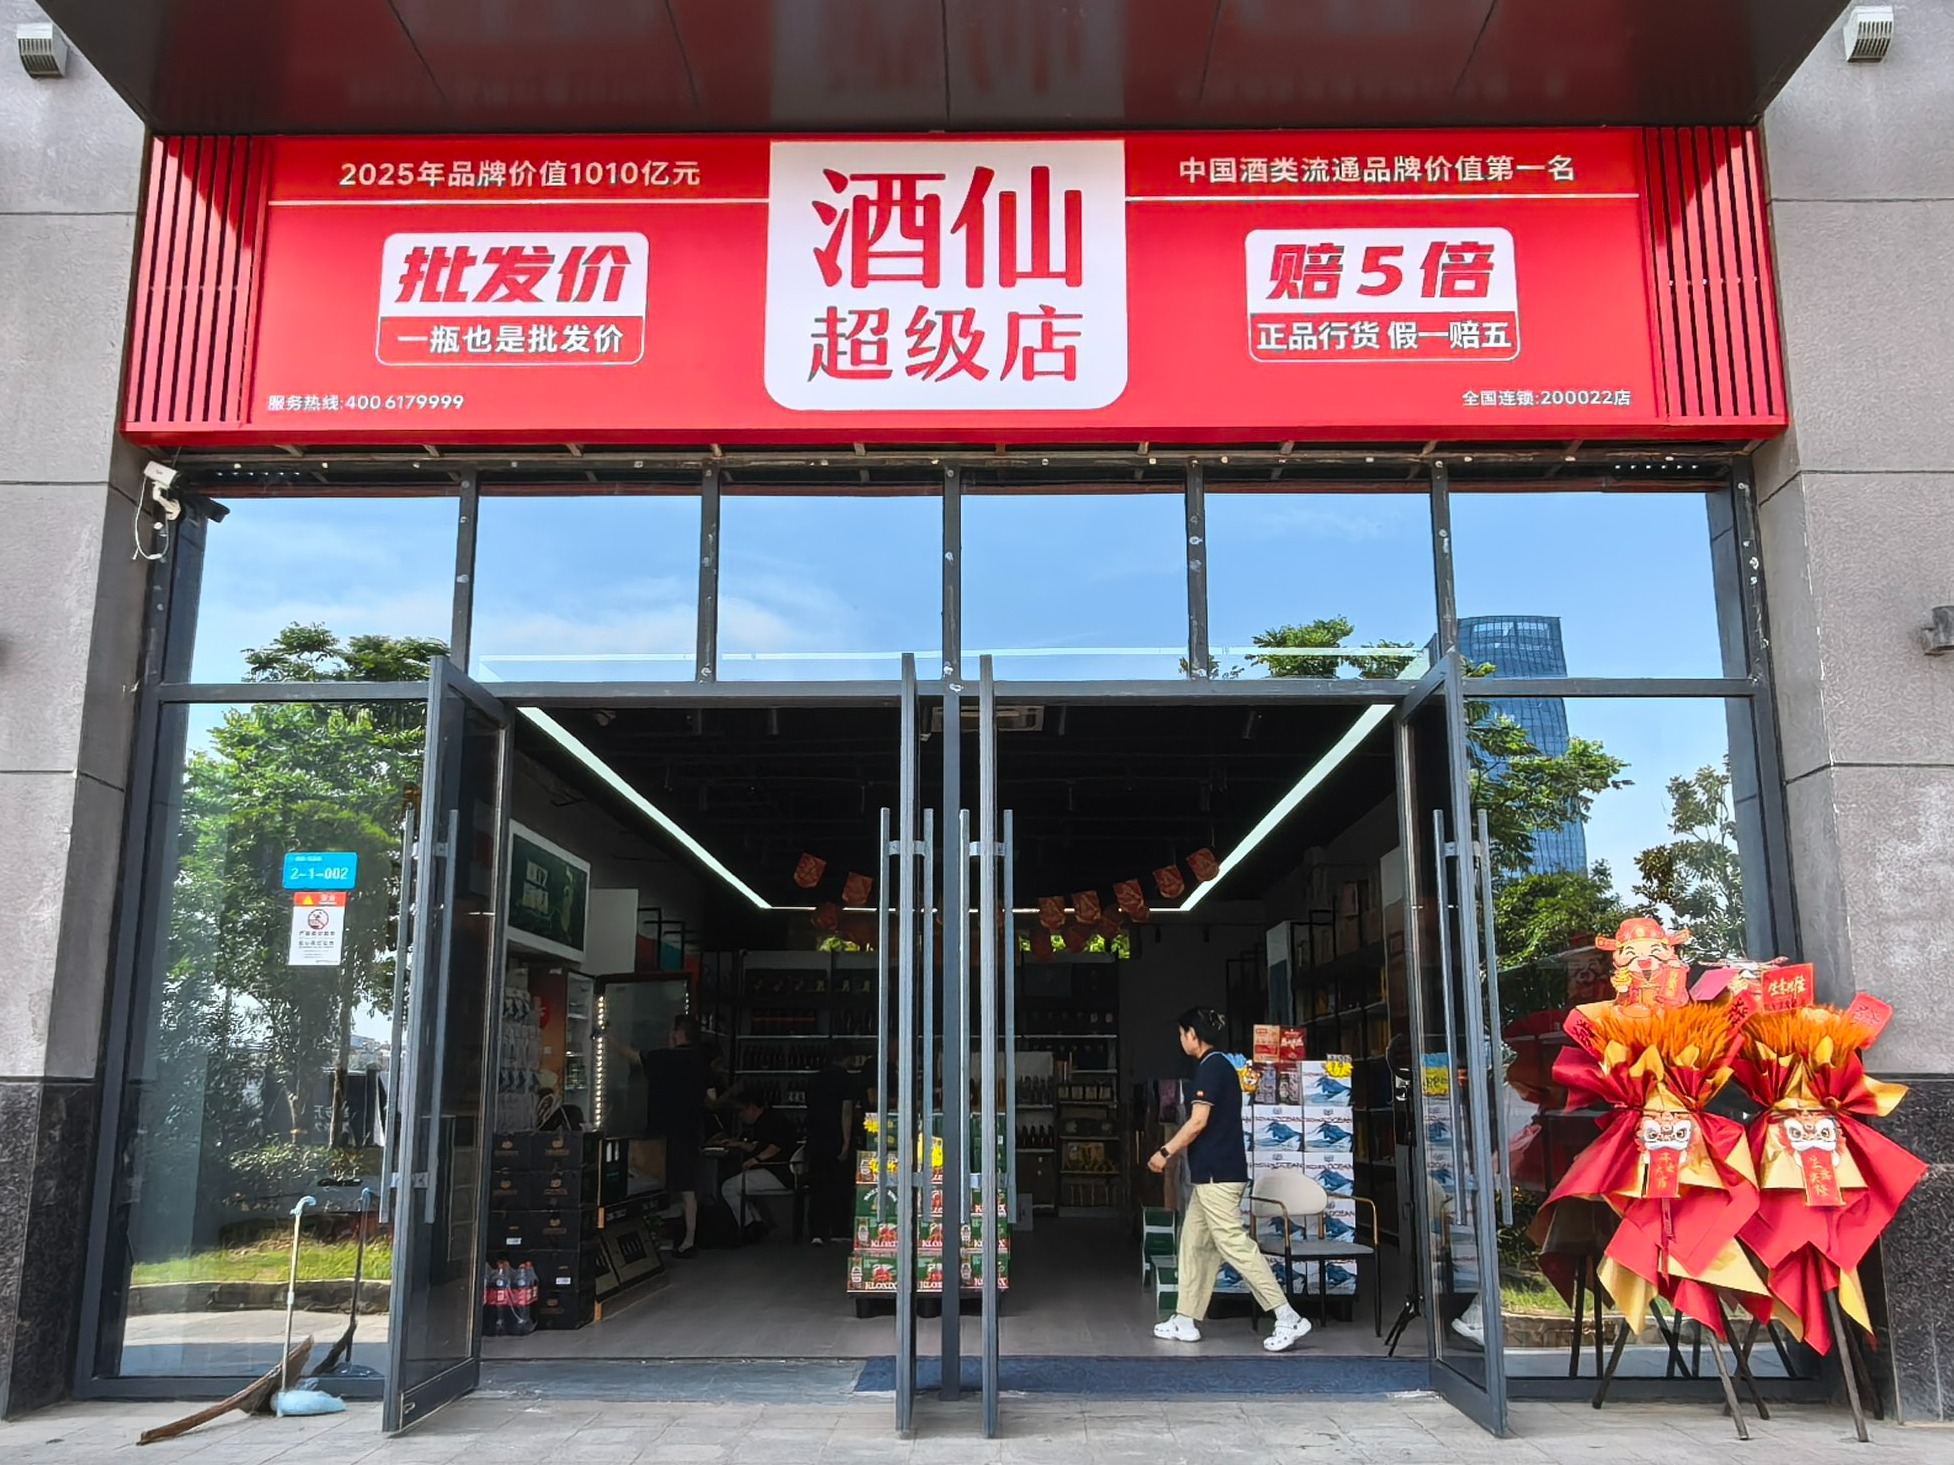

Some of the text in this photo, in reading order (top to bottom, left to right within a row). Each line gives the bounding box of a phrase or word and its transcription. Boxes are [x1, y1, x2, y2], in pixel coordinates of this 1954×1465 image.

[339, 159, 702, 188] 2025年品牌价值1010亿元
[1179, 156, 1577, 184] 中国酒类流通品牌价值第一名
[812, 165, 1082, 288] 酒仙
[394, 244, 632, 303] 批发价
[1265, 241, 1495, 300] 赔5倍
[397, 323, 625, 355] 一瓶也是批发价
[808, 304, 1083, 383] 超级店
[1256, 320, 1511, 351] 正品行货 假一赔五
[1462, 389, 1632, 408] 全国连锁:200022店
[290, 867, 349, 880] 2-1-002
